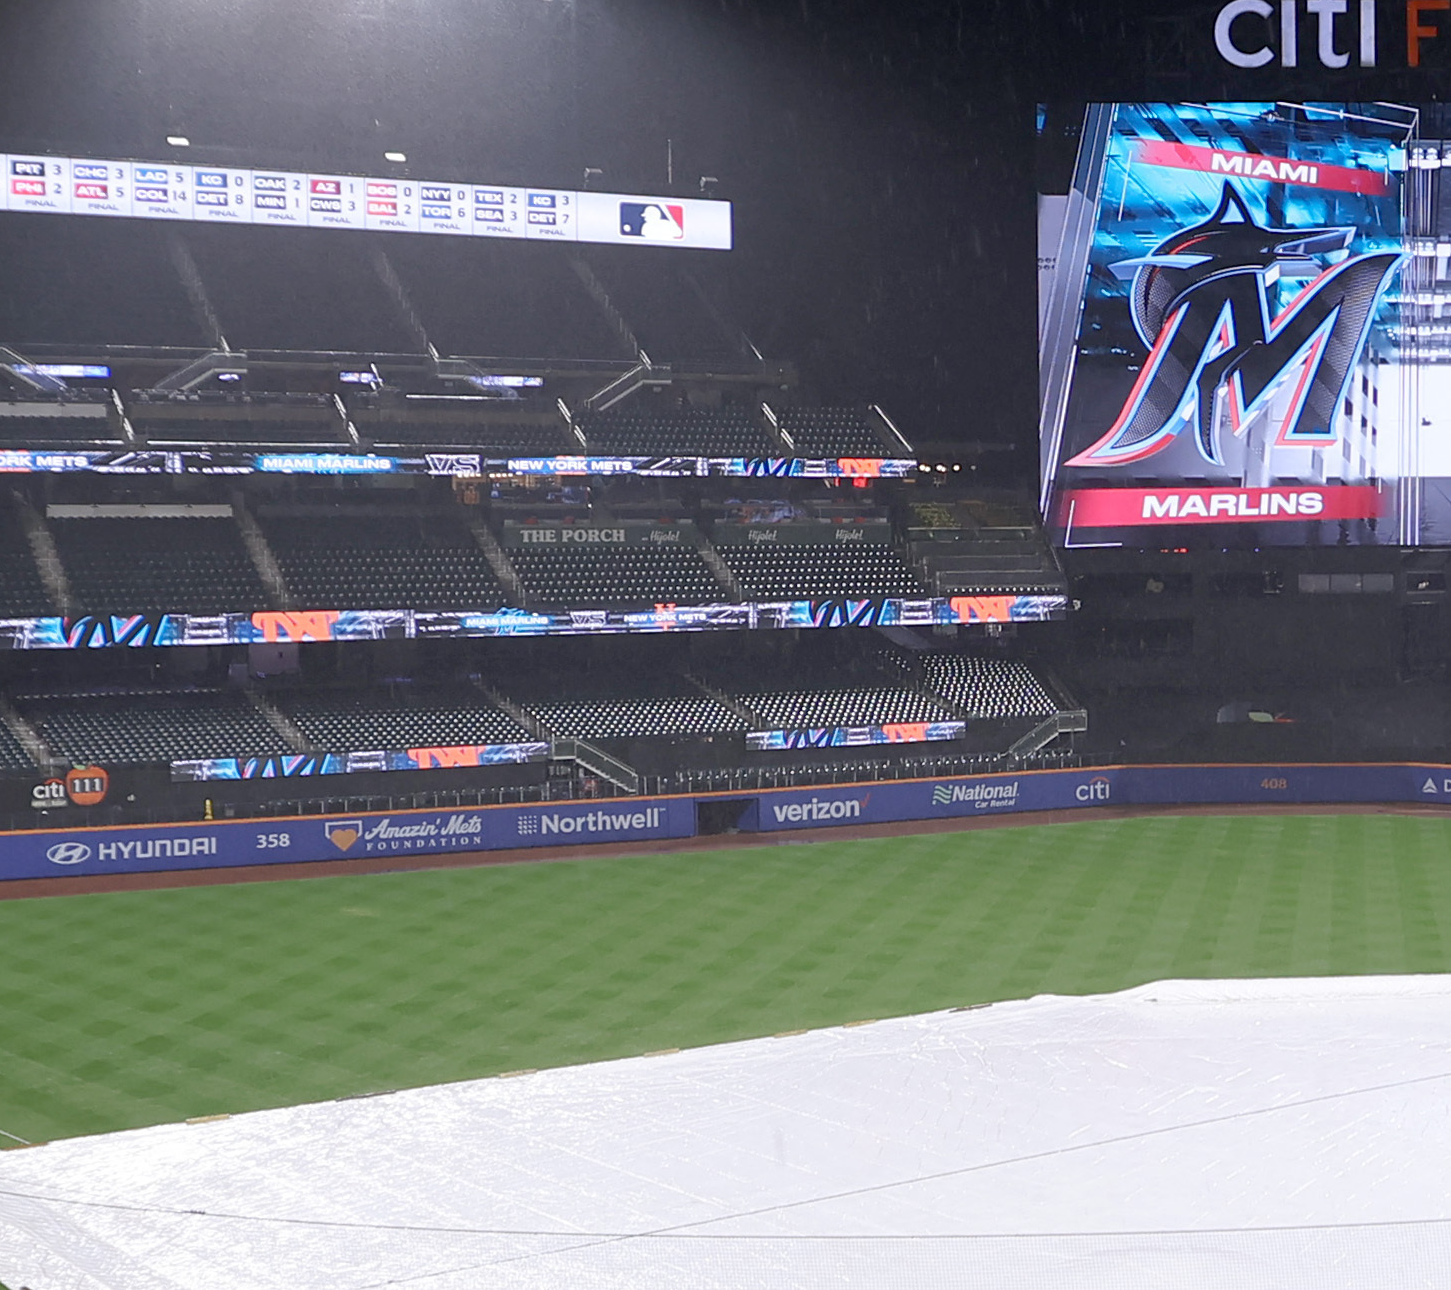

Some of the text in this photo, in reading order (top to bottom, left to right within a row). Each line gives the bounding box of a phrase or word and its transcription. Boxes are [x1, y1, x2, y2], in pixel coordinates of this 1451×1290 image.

[1211, 152, 1318, 185] MIAMI
[36, 454, 88, 467] METS
[263, 457, 314, 469] MIAMI
[317, 457, 392, 469] MARLINS
[507, 459, 543, 471] NEW
[546, 459, 588, 471] YORK
[591, 460, 633, 472] METS
[1141, 491, 1323, 519] MARLINS
[520, 529, 625, 543] THE PORCH
[32, 779, 65, 799] citi
[73, 778, 101, 793] 111
[951, 781, 1019, 803] National
[1076, 778, 1110, 801] citi
[1261, 777, 1288, 789] 408
[773, 797, 860, 823] verizon
[975, 798, 1016, 809] Car Rental
[364, 814, 482, 841] Amazin' Mets
[541, 808, 660, 835] Northwell
[98, 835, 218, 861] HYUNDAI
[256, 832, 291, 849] 358
[365, 835, 482, 852] FOUNDATION
